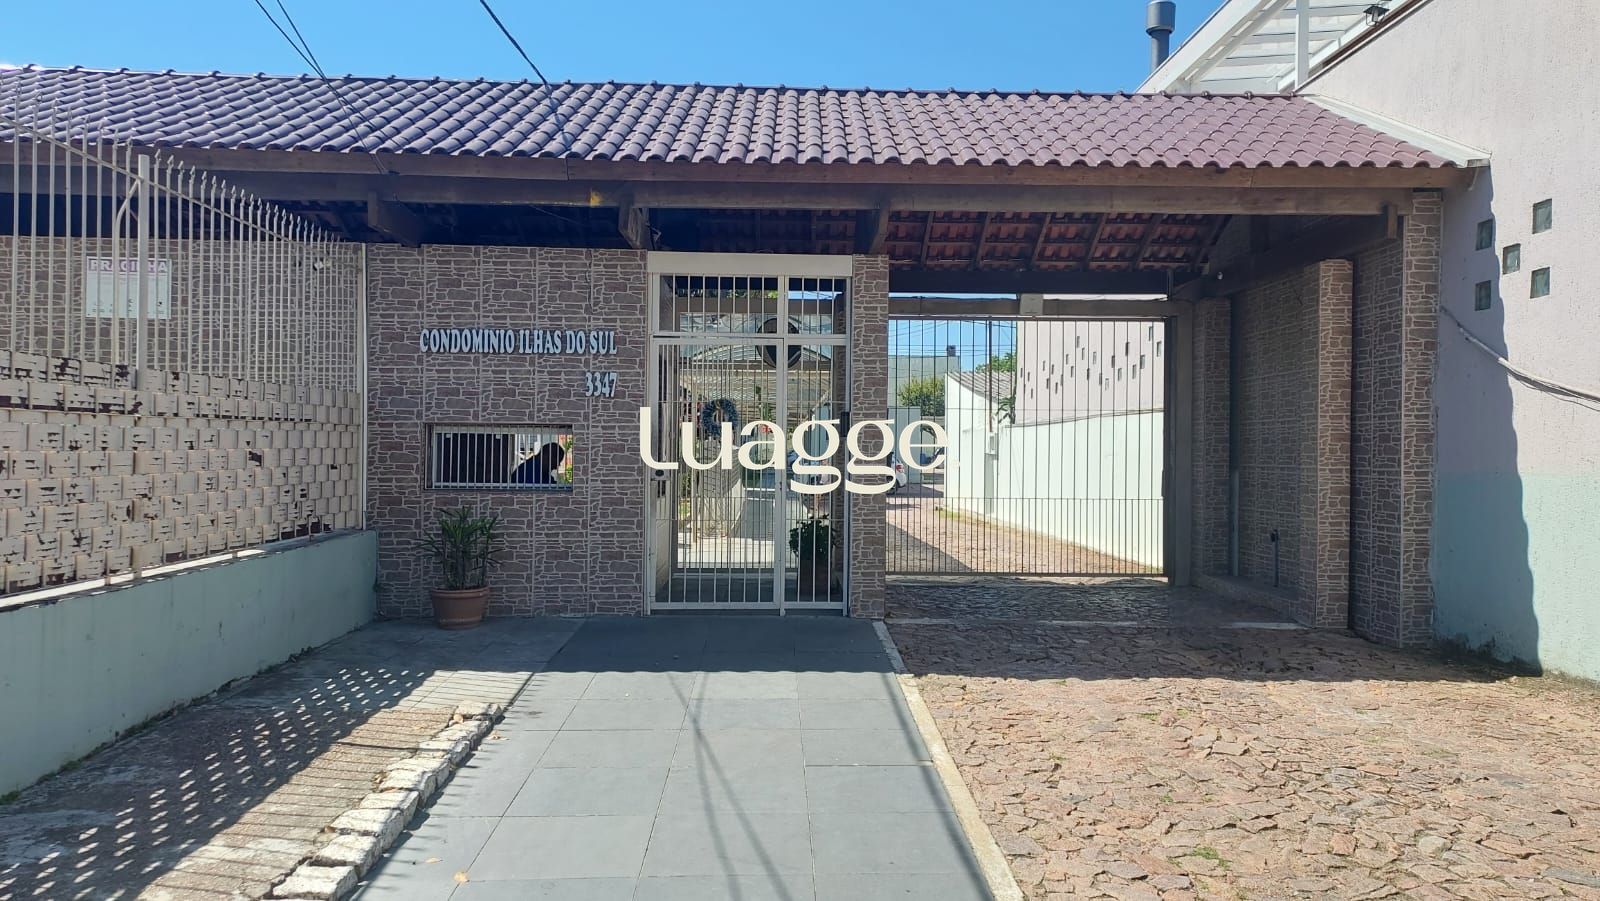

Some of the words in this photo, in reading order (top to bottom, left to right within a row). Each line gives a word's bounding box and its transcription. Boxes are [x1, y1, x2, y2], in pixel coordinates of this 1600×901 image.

[419, 328, 515, 354] CONDOMINIO
[518, 329, 562, 355] ILHAS
[565, 330, 586, 355] DO
[589, 330, 618, 355] SUL
[585, 371, 618, 398] 3347
